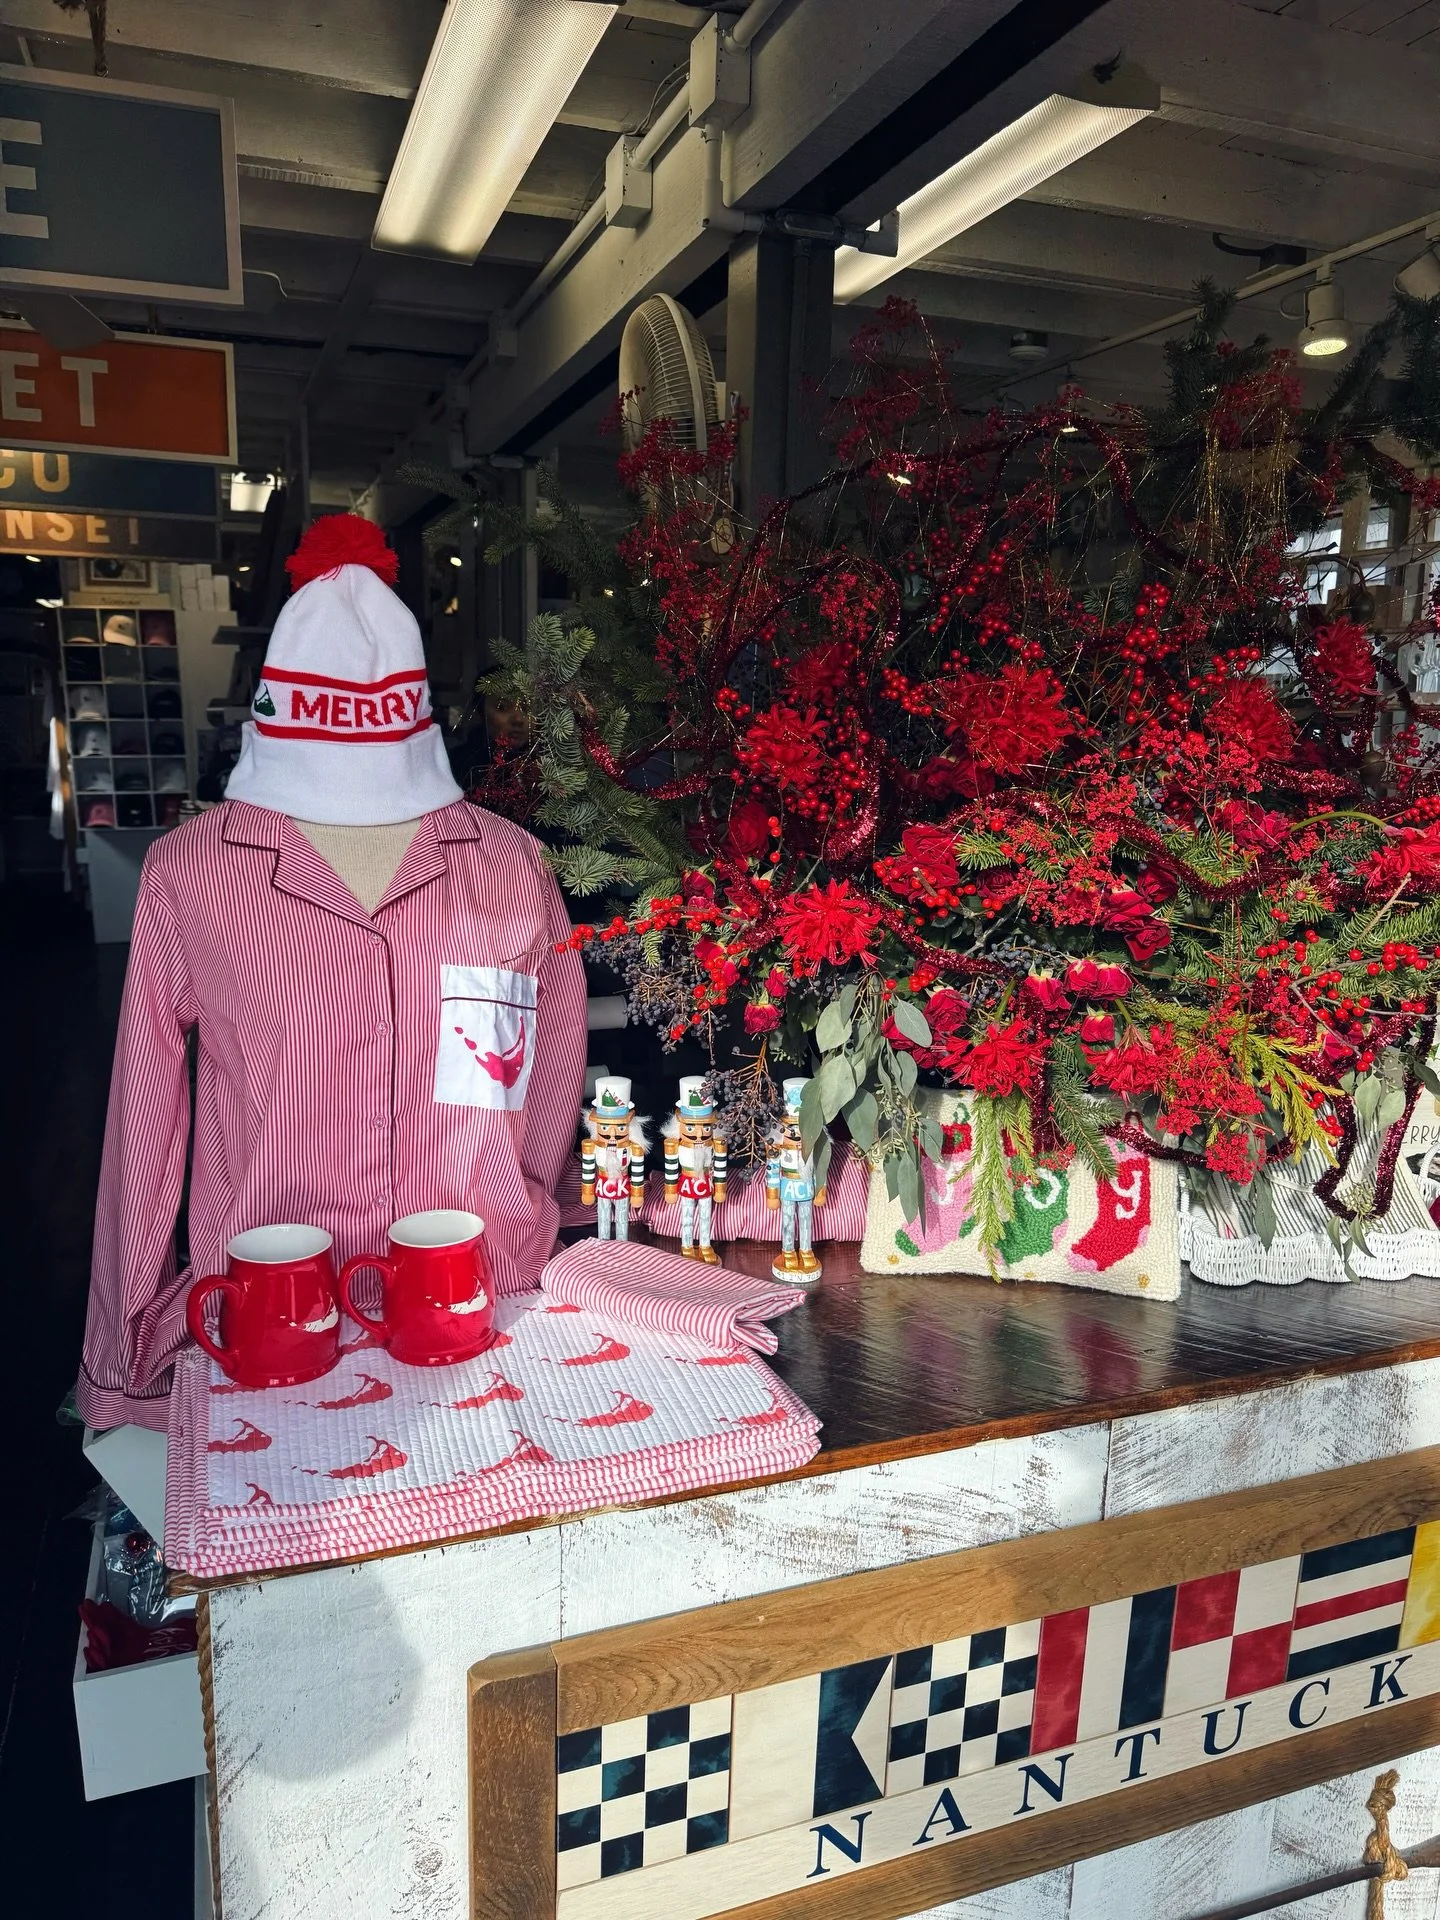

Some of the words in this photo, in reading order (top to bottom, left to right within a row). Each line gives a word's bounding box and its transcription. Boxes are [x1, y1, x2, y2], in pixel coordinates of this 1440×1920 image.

[0, 350, 108, 427] ET
[291, 687, 422, 728] MERRY
[595, 1178, 629, 1197] ACK
[807, 1654, 1413, 1879] NANTUCK
